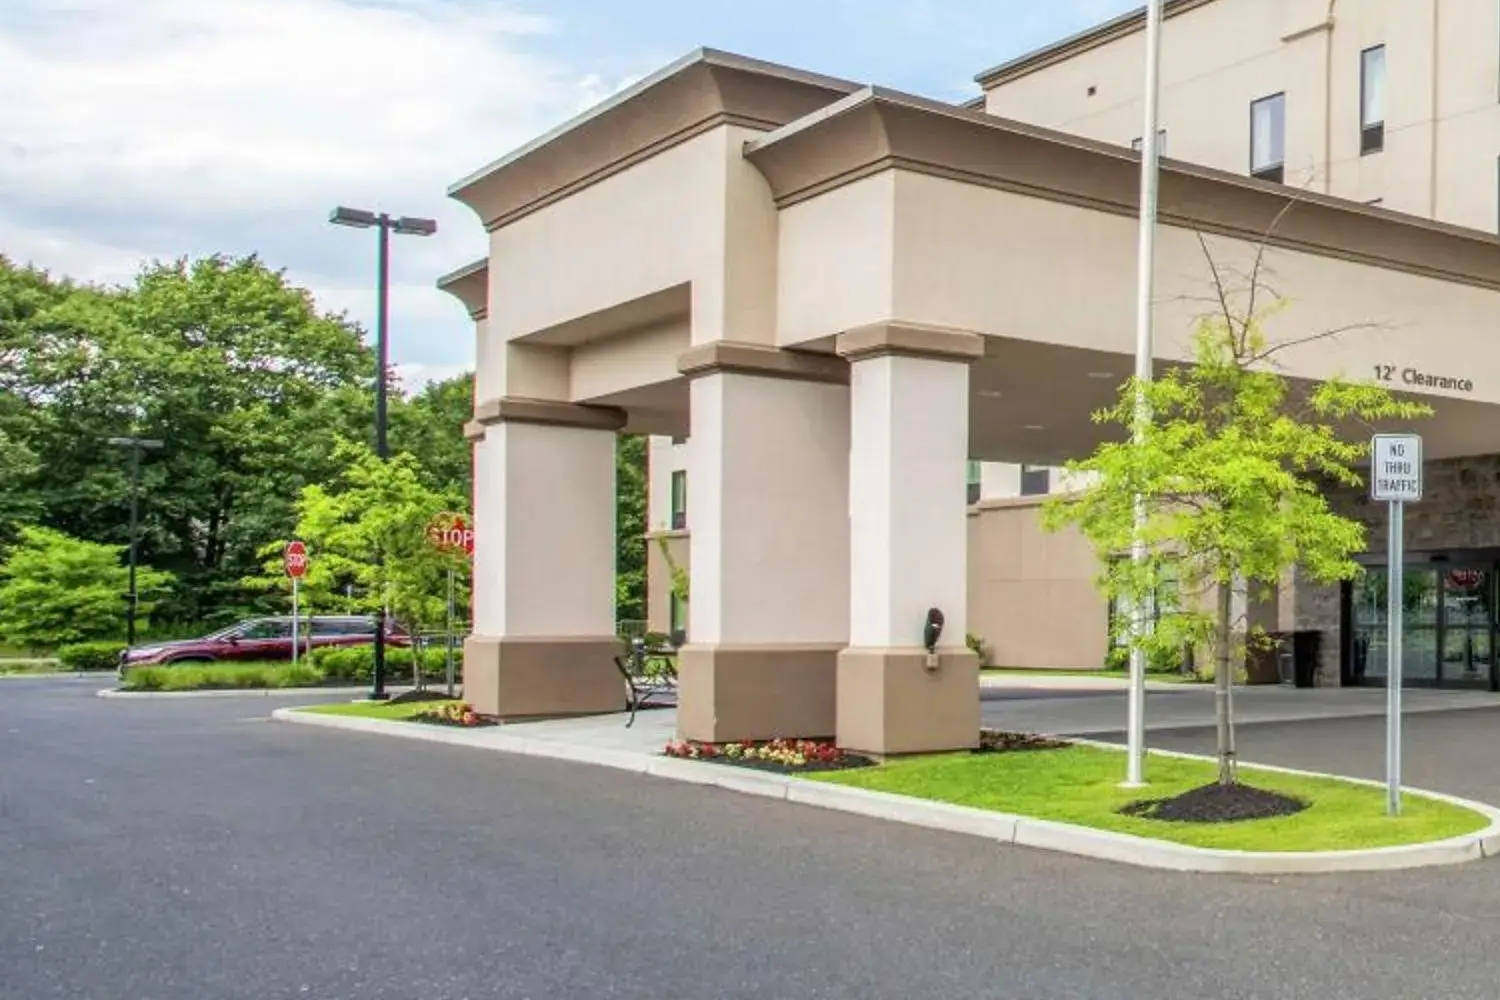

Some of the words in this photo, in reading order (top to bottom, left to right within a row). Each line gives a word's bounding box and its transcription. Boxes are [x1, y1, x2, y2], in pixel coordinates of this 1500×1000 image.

[1402, 368, 1474, 391] Clearance
[1390, 444, 1405, 457] NO
[1385, 461, 1411, 474] THRU
[1378, 479, 1417, 492] TRAFFIC
